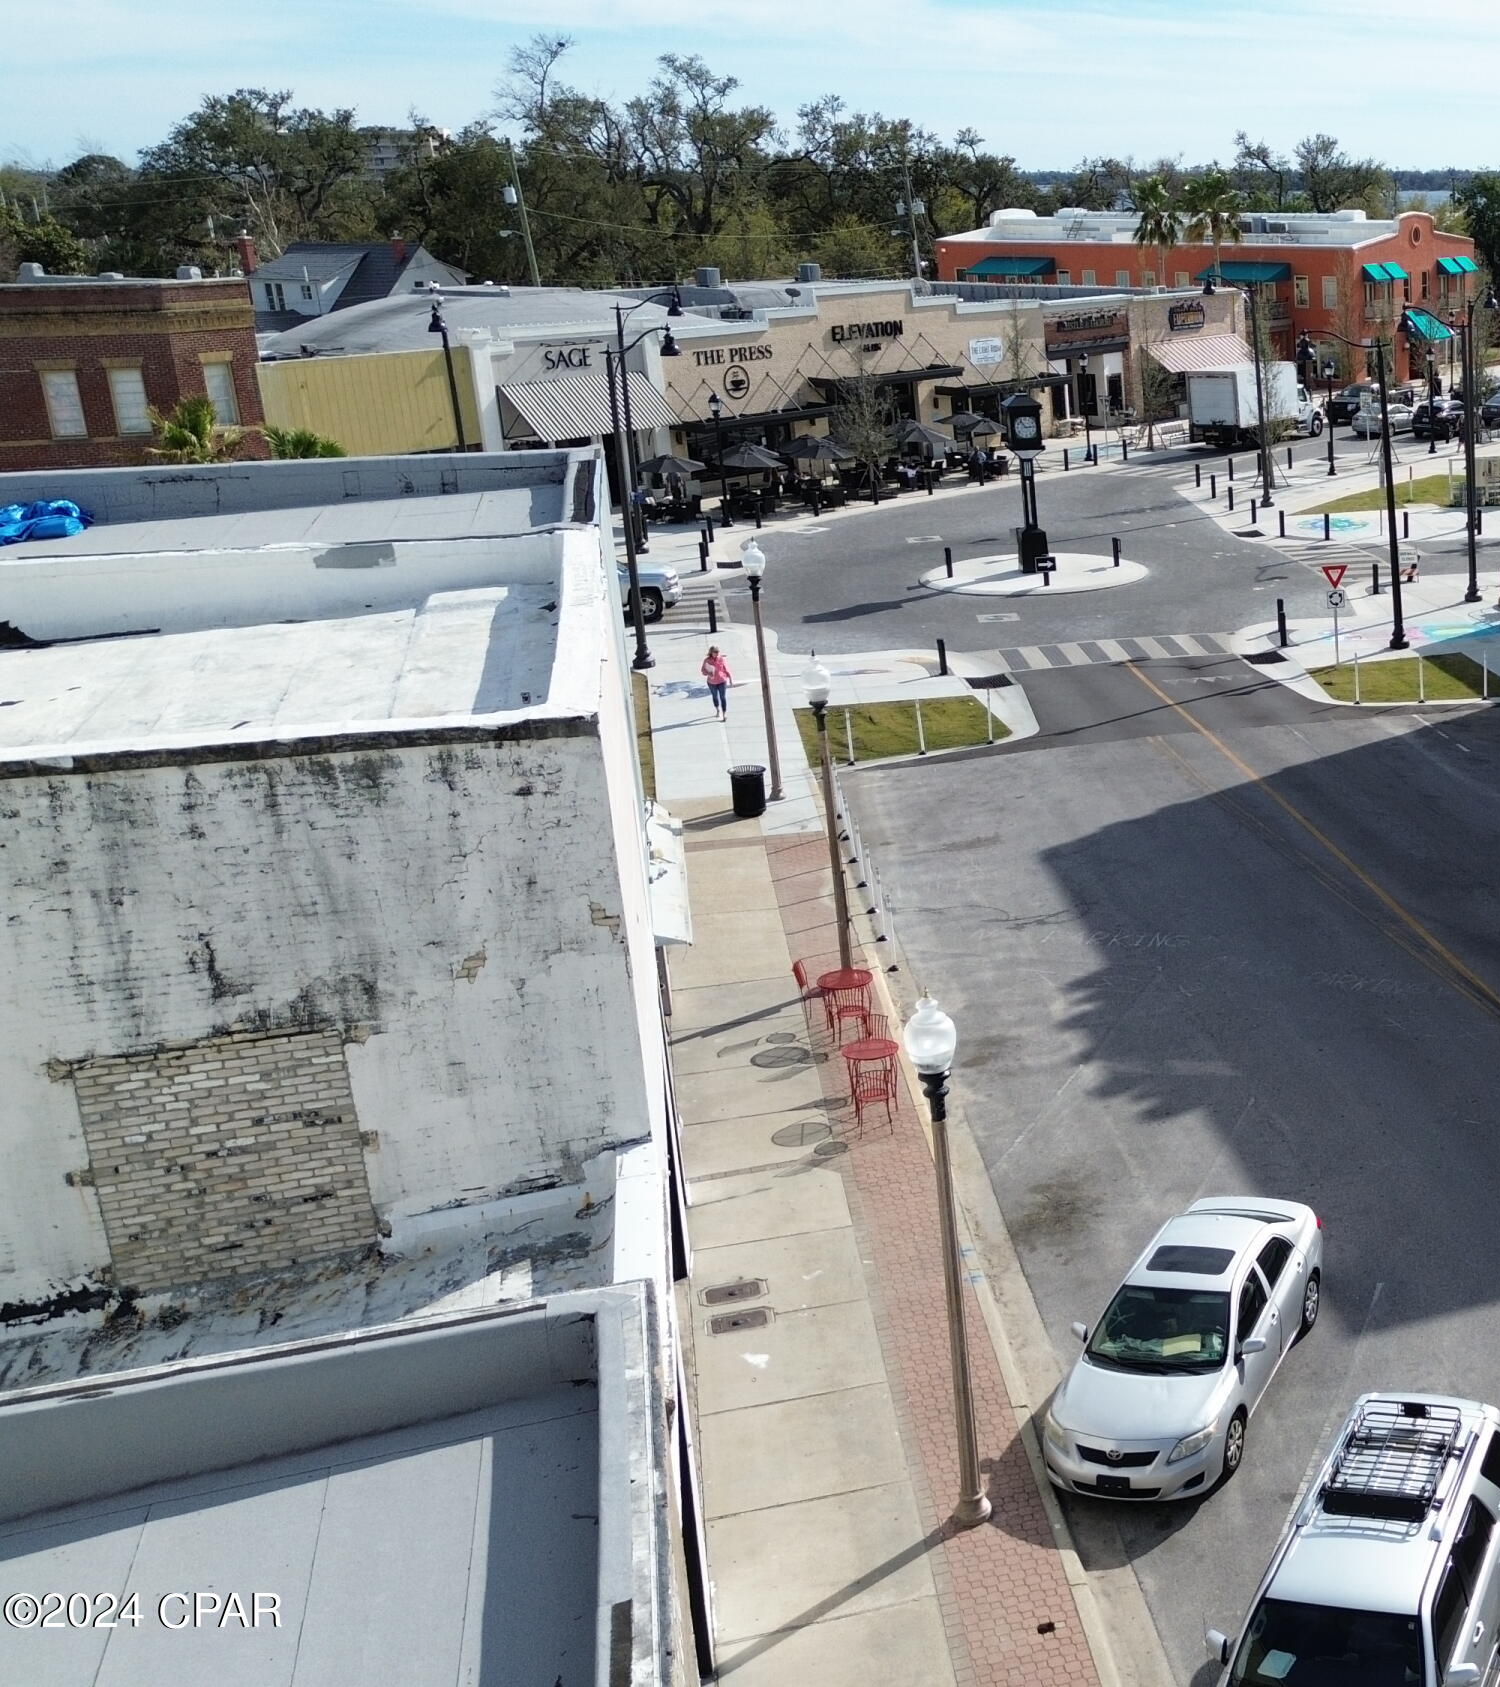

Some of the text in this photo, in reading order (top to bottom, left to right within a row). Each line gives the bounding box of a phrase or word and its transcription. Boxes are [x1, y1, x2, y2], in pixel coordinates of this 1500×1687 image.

[831, 319, 904, 342] ELEVATION
[544, 347, 593, 370] SAGE
[692, 344, 774, 367] THE PRESS
